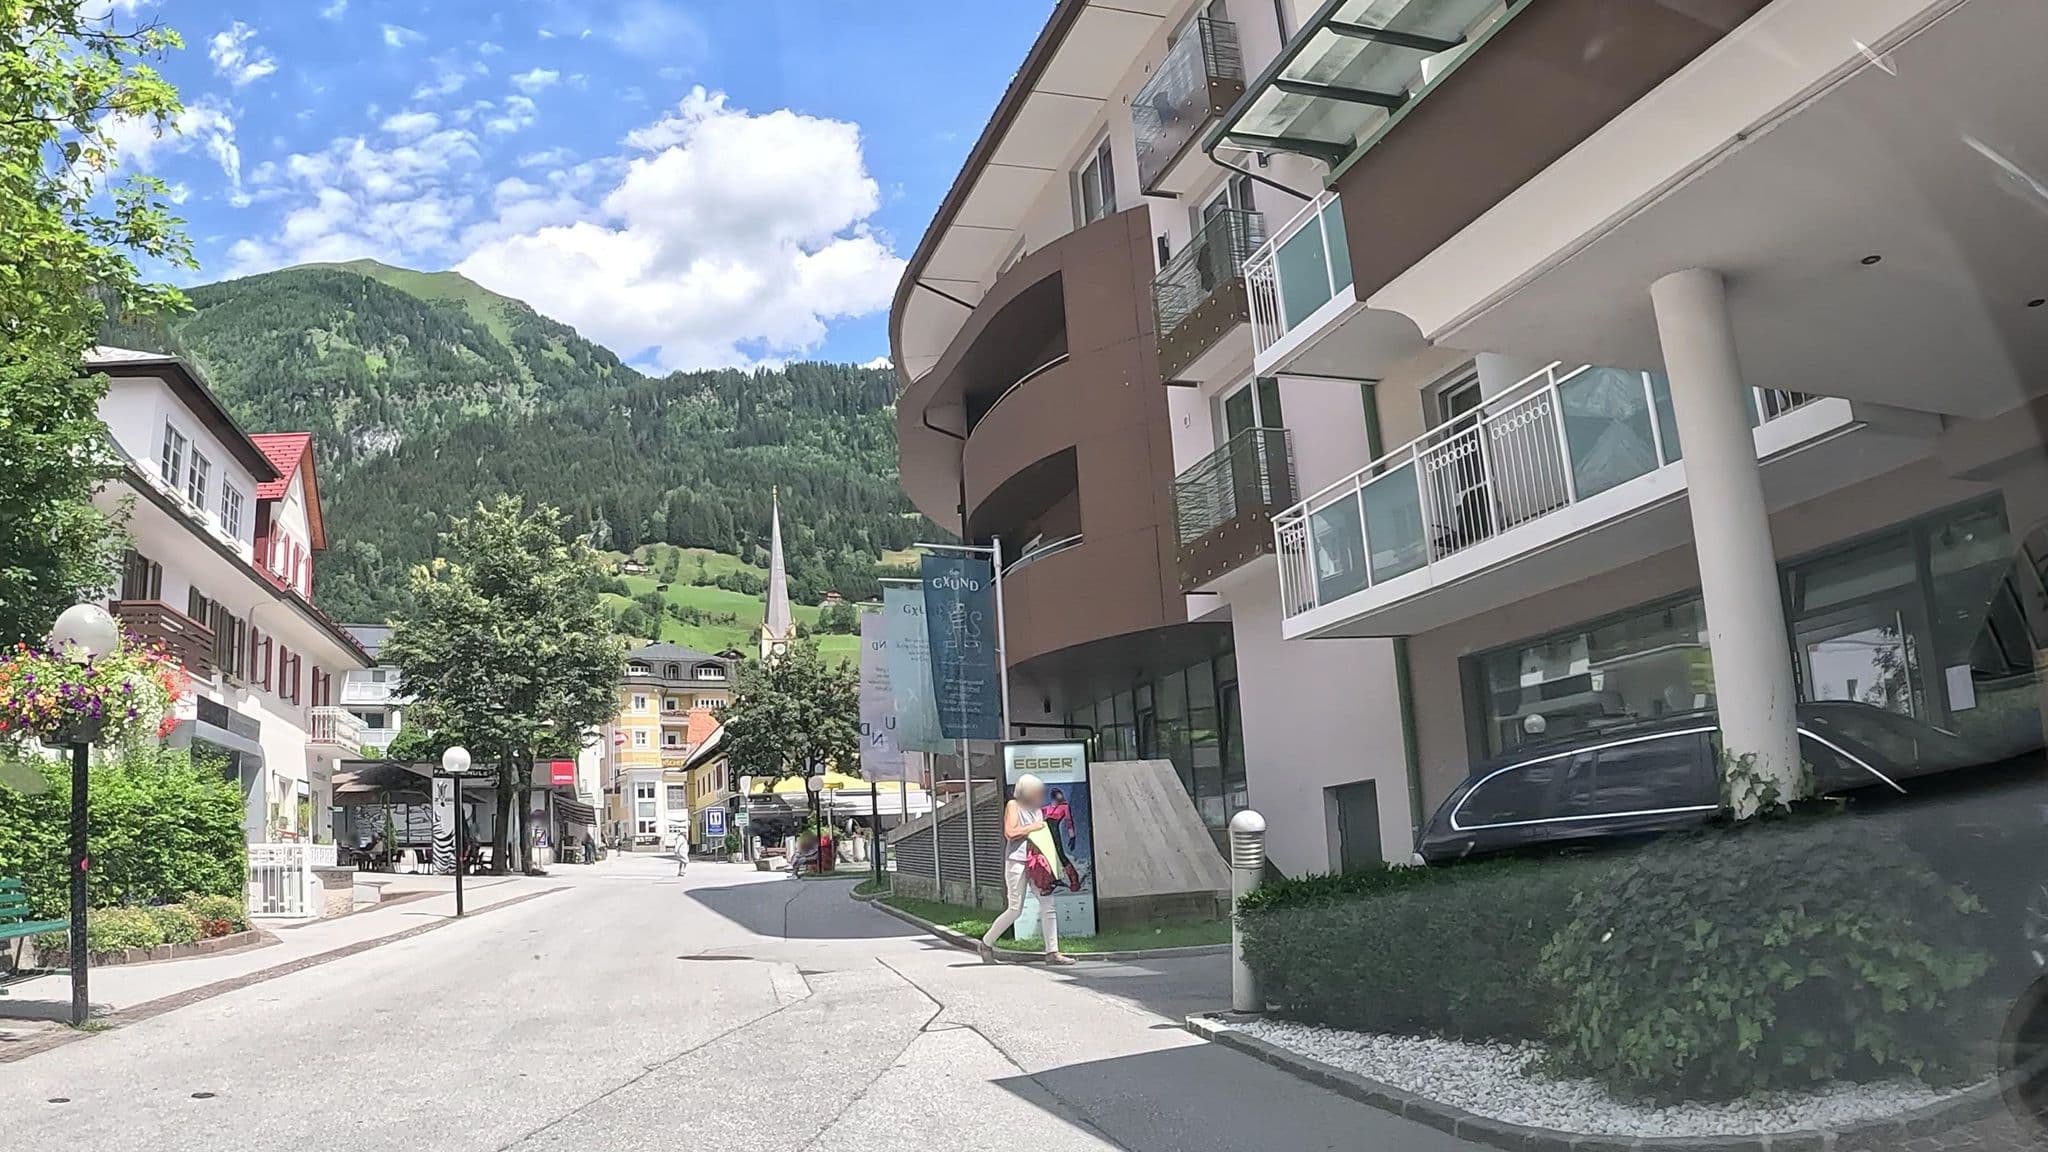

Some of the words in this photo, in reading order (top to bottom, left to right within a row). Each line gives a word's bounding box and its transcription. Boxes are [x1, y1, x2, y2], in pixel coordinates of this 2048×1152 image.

[932, 575, 979, 592] GXUND
[903, 603, 925, 617] GXU
[1013, 757, 1073, 770] EGGER
